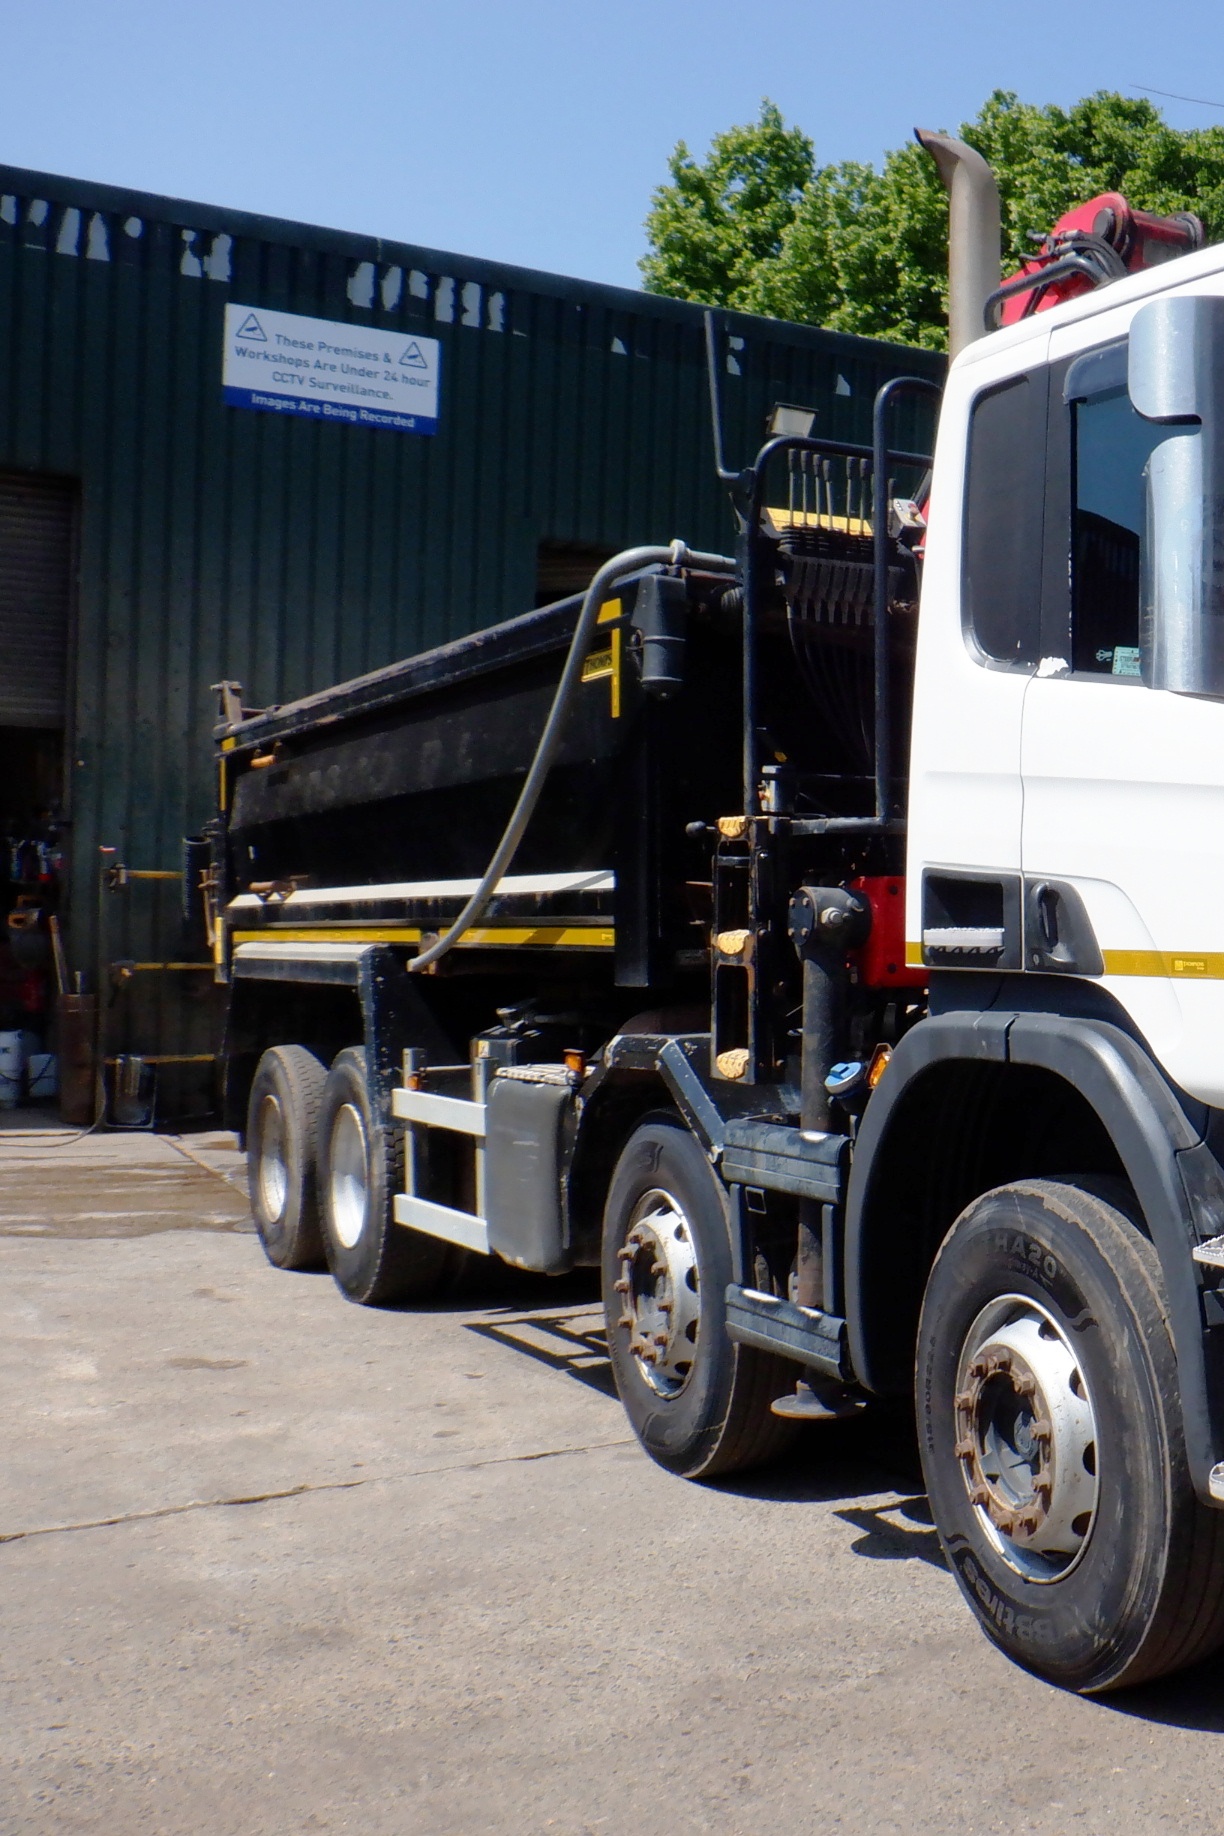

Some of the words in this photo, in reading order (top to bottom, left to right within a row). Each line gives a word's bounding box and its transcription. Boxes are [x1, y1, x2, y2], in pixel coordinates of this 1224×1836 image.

[275, 333, 314, 351] These
[318, 341, 379, 362] Premises
[383, 352, 392, 364] &
[234, 345, 310, 369] Workshops
[314, 360, 337, 373] Are
[341, 364, 380, 379] Under
[384, 370, 399, 382] 24
[402, 374, 431, 388] hour
[272, 371, 305, 386] CCTV
[251, 393, 296, 411] Images
[298, 400, 321, 413] Are
[323, 404, 357, 421] Being
[359, 411, 415, 428] Recorded
